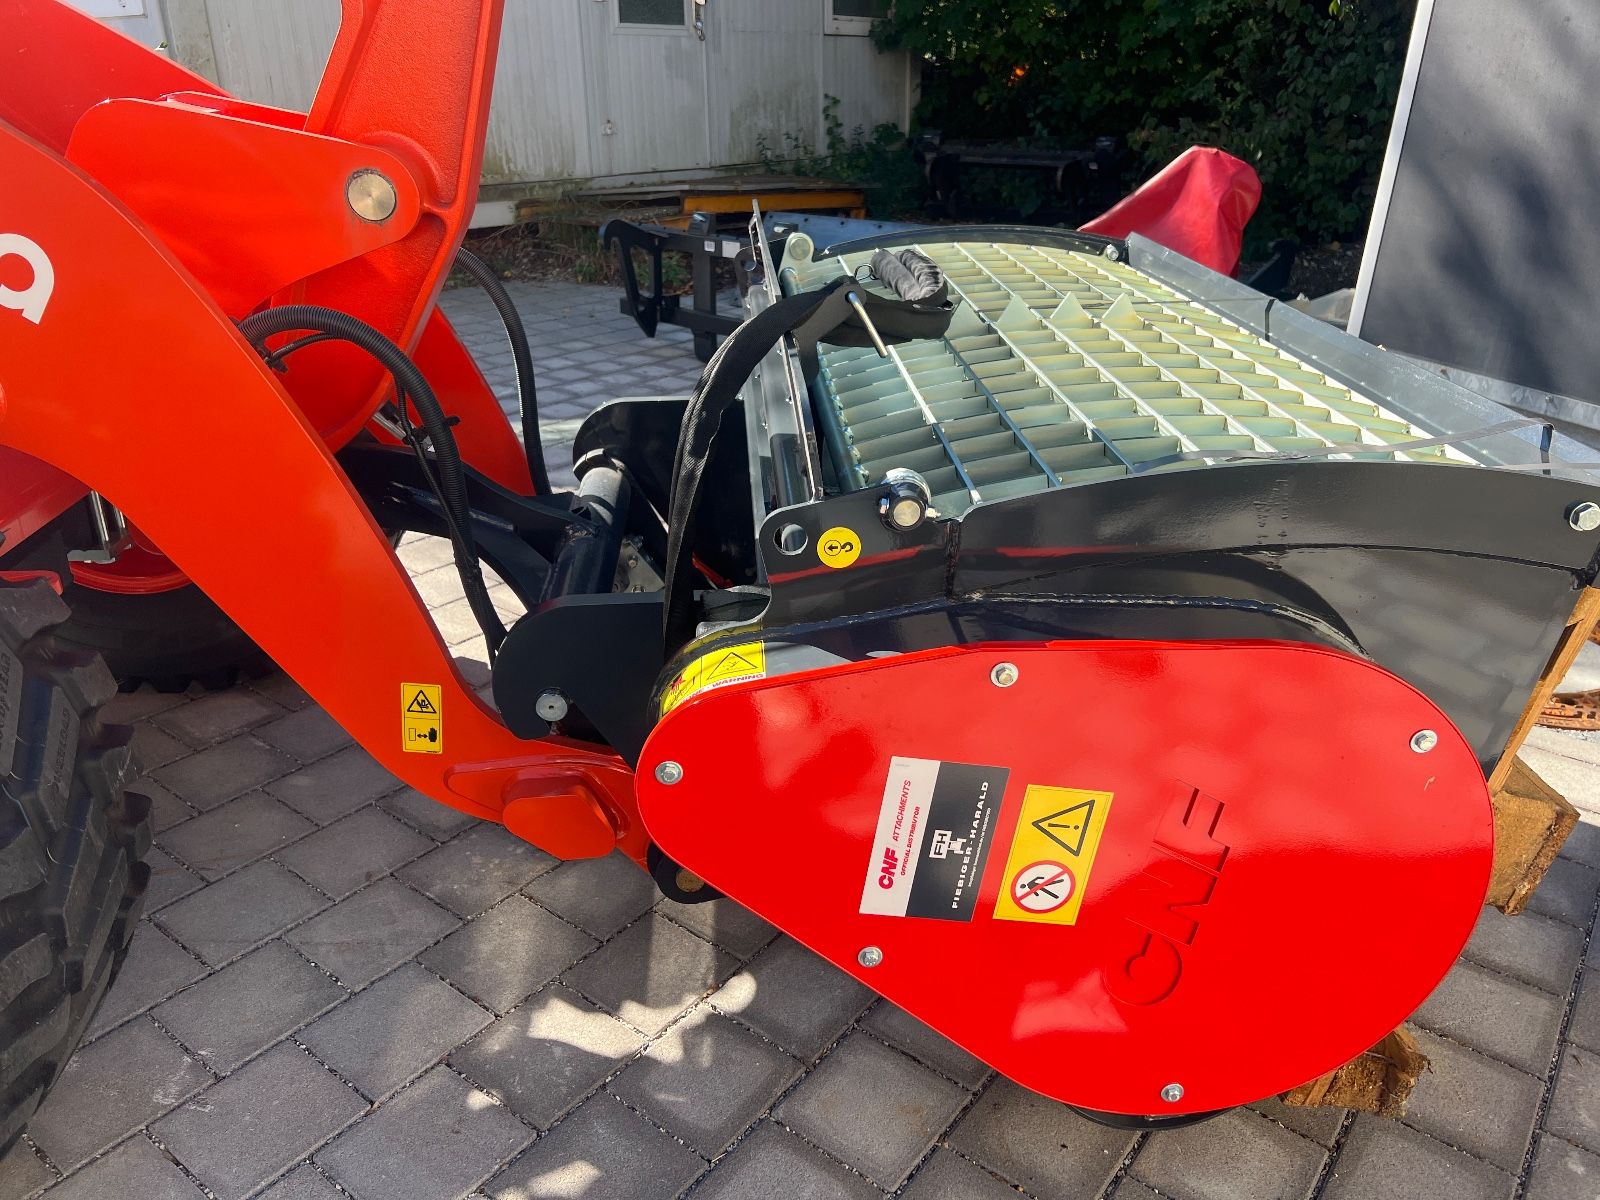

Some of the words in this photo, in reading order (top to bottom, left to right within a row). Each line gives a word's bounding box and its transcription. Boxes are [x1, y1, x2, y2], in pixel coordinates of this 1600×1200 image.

[712, 674, 763, 688] WARNING
[879, 848, 899, 889] CNF
[893, 780, 911, 842] ATTACHMENTS
[900, 843, 912, 876] OFFICIAL
[907, 806, 920, 848] DISTRIBUTOR
[933, 833, 947, 856] FH
[1102, 778, 1230, 1006] CNF
